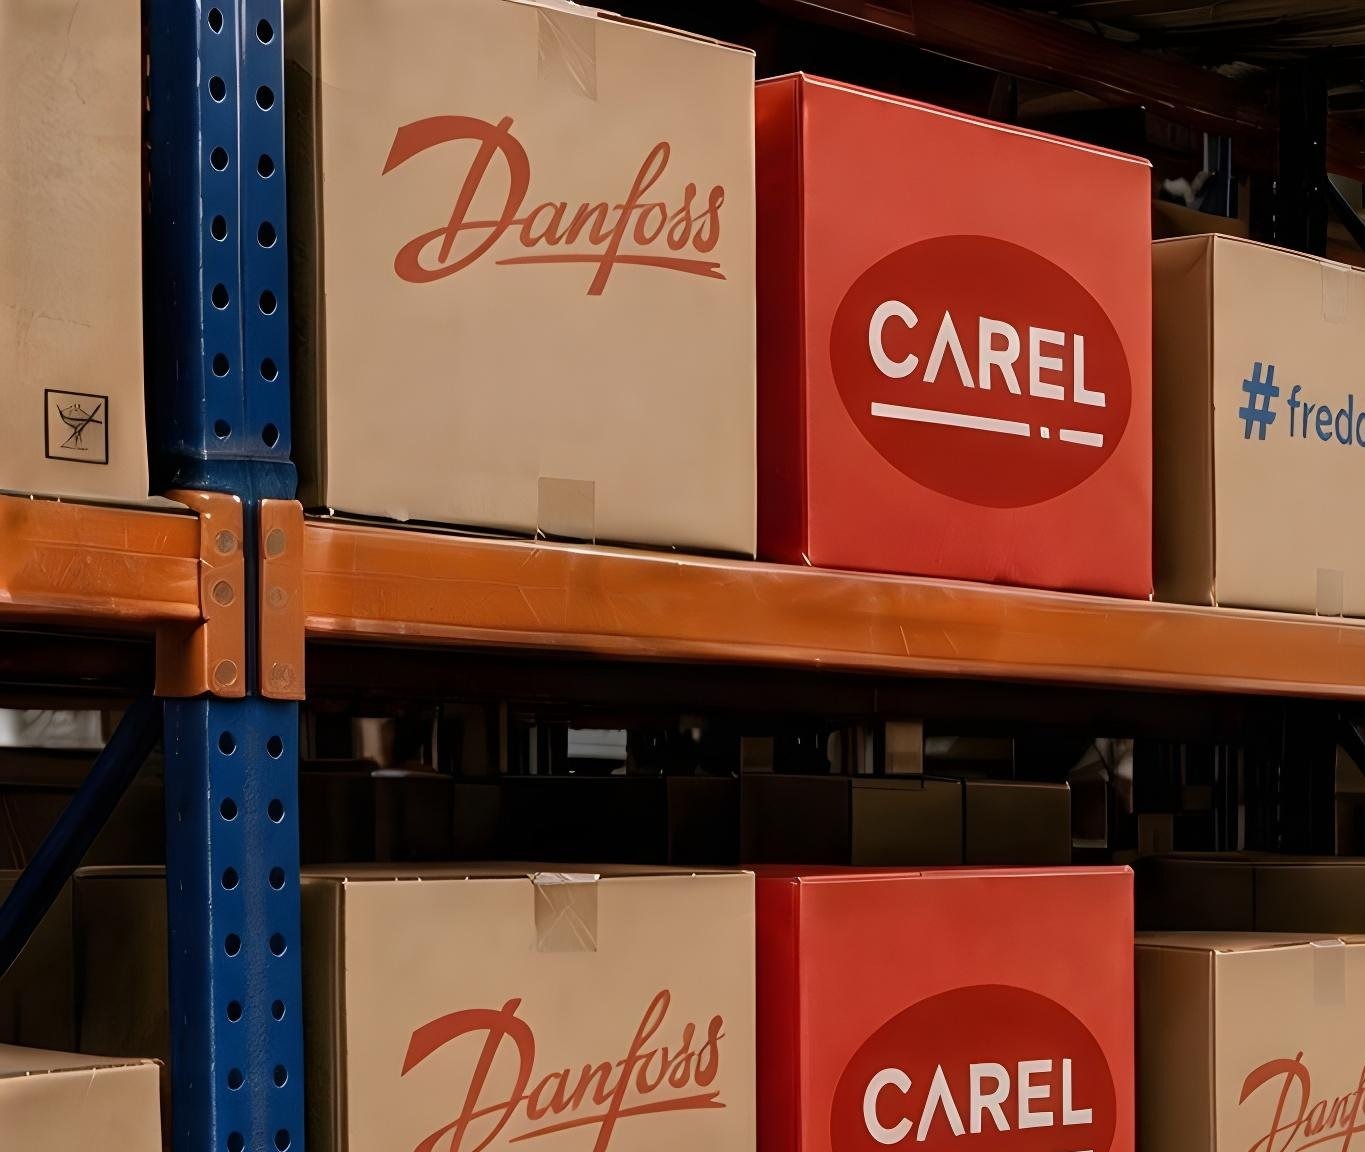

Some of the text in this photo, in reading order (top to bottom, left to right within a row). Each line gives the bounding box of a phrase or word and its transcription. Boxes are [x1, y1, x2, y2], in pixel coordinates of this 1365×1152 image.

[382, 115, 727, 296] Danfoss
[868, 300, 1106, 408] CAREL
[862, 1058, 1094, 1145] CAREL
